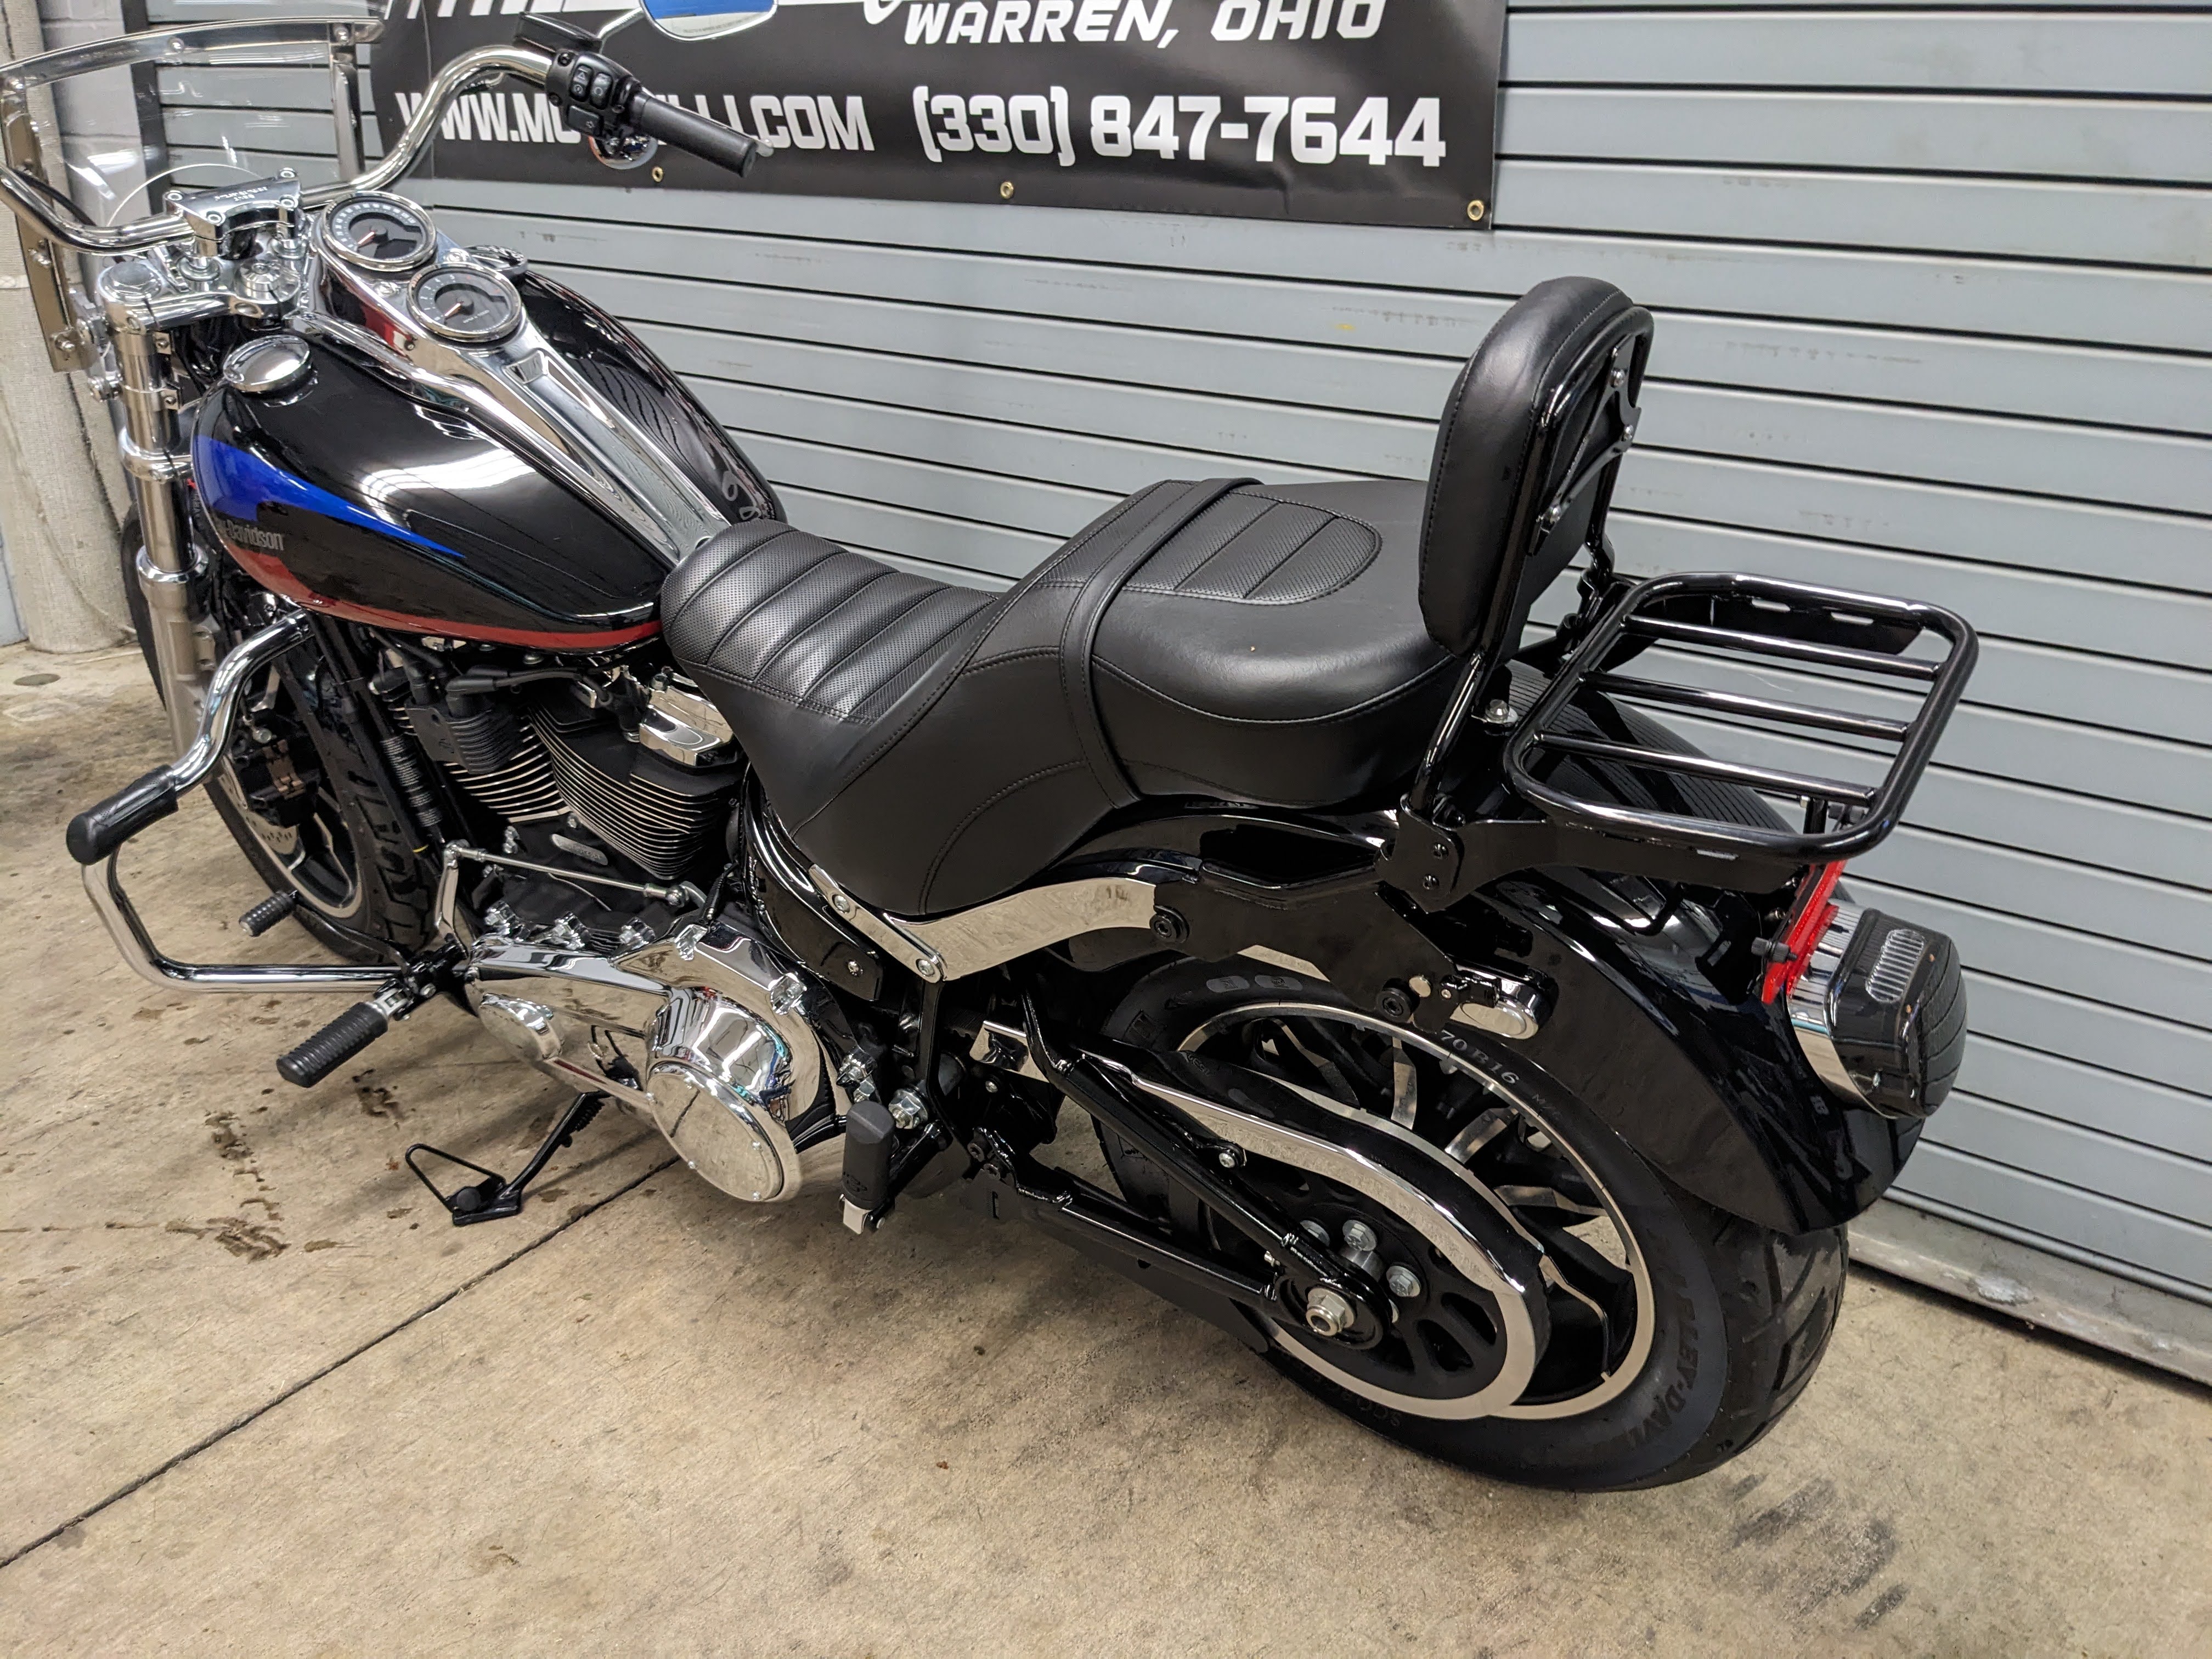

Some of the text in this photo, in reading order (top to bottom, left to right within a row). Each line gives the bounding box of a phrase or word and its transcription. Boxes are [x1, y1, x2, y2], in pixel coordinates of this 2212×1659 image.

[904, 0, 1386, 49] WARREN, OHIO
[912, 86, 1076, 167] (330)
[1090, 94, 1447, 168] 847-7644
